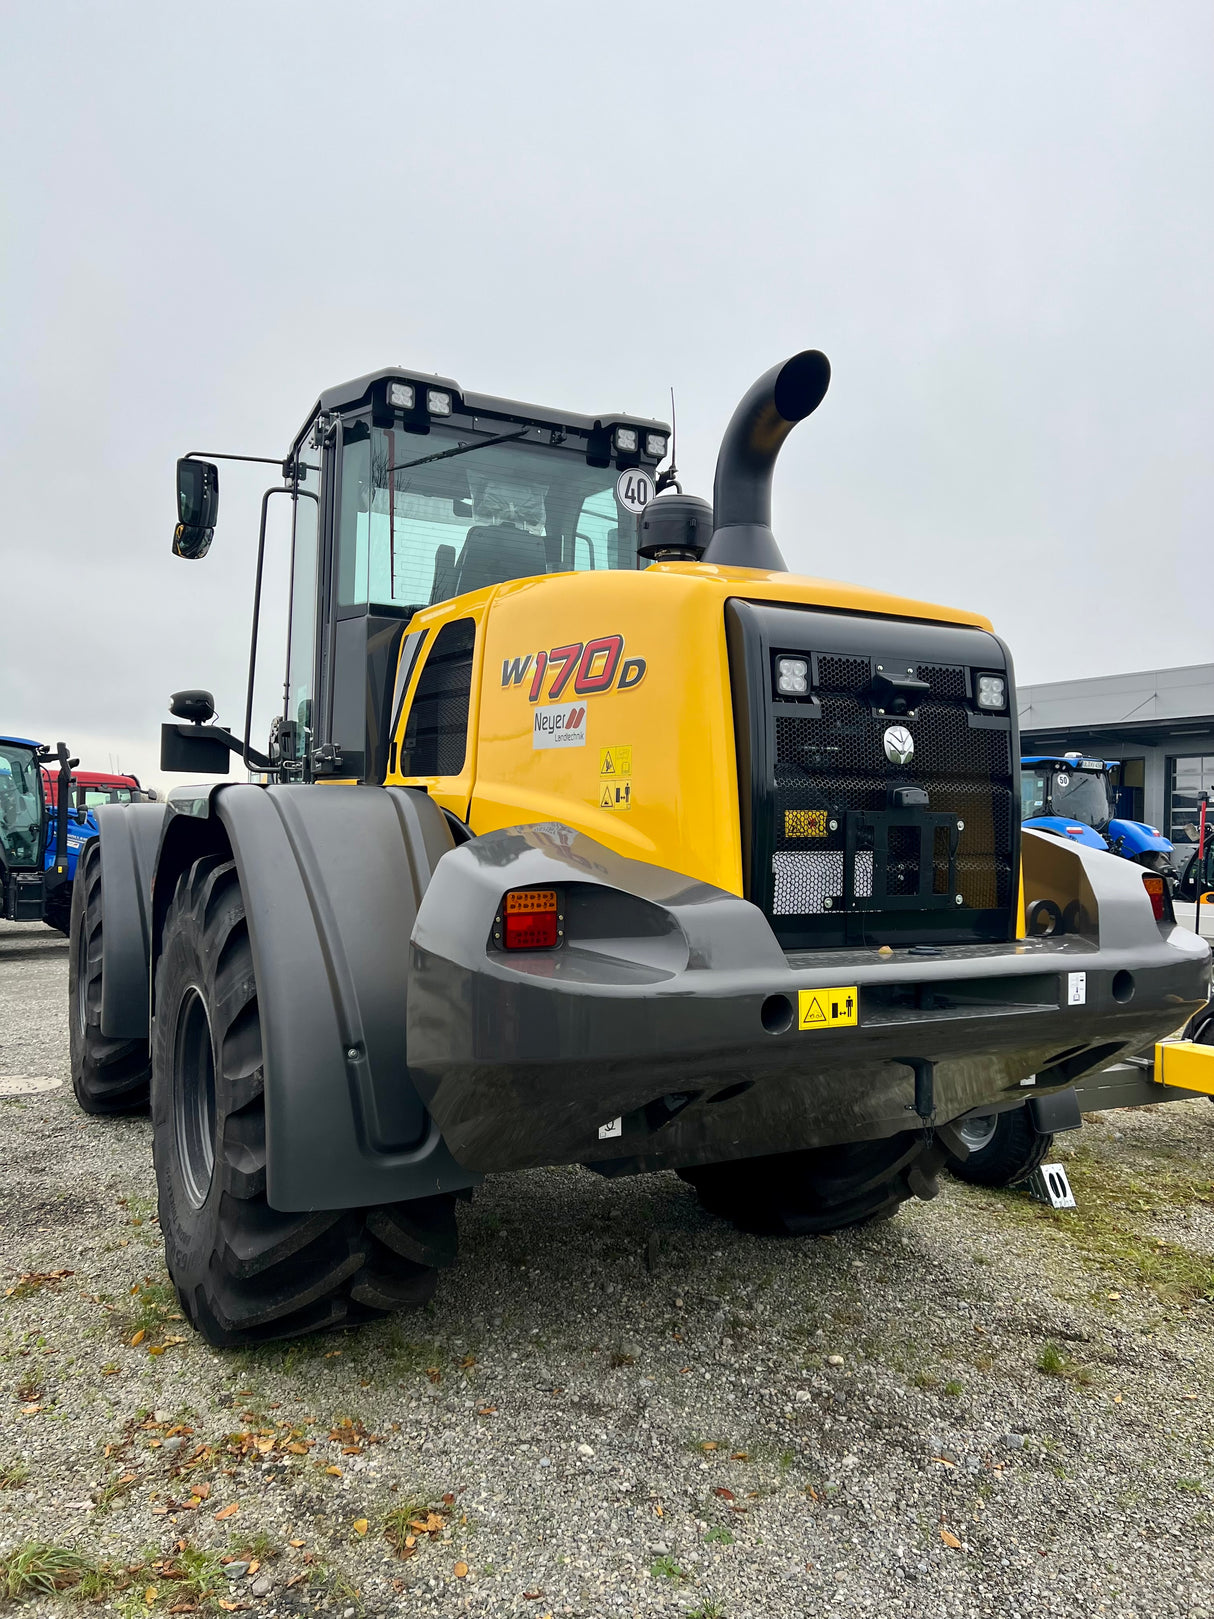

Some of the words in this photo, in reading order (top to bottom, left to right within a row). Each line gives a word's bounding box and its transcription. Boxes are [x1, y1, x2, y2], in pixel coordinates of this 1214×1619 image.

[625, 476, 648, 505] 40
[534, 712, 566, 734] Neyer
[554, 731, 585, 743] Landtechnik
[1059, 776, 1068, 785] 50
